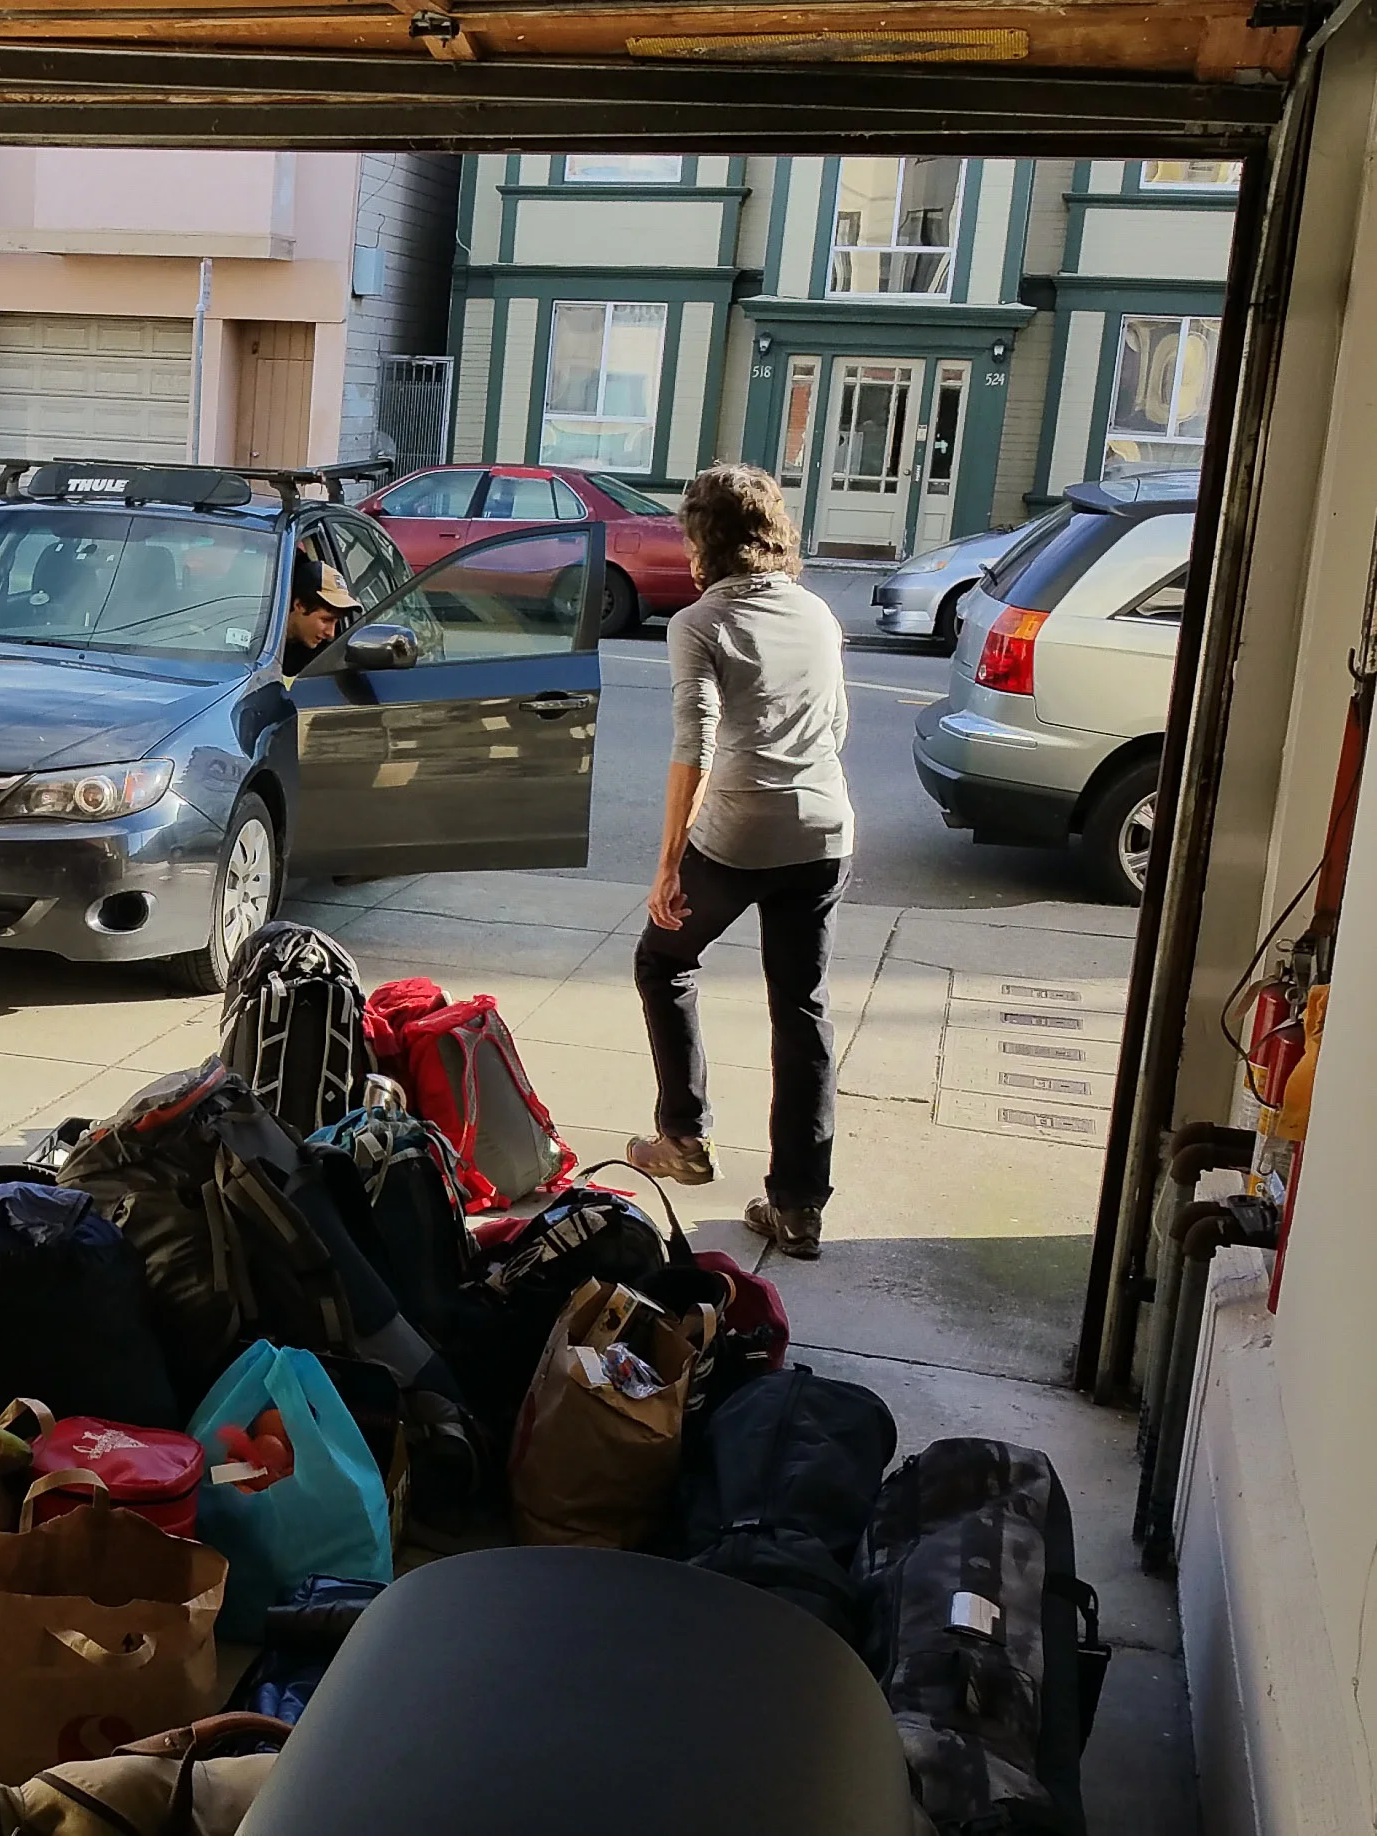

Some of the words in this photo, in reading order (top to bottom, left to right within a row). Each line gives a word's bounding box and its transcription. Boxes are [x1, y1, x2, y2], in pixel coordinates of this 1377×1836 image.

[752, 365, 772, 378] 518
[985, 372, 1005, 386] 524
[67, 478, 130, 492] THULE
